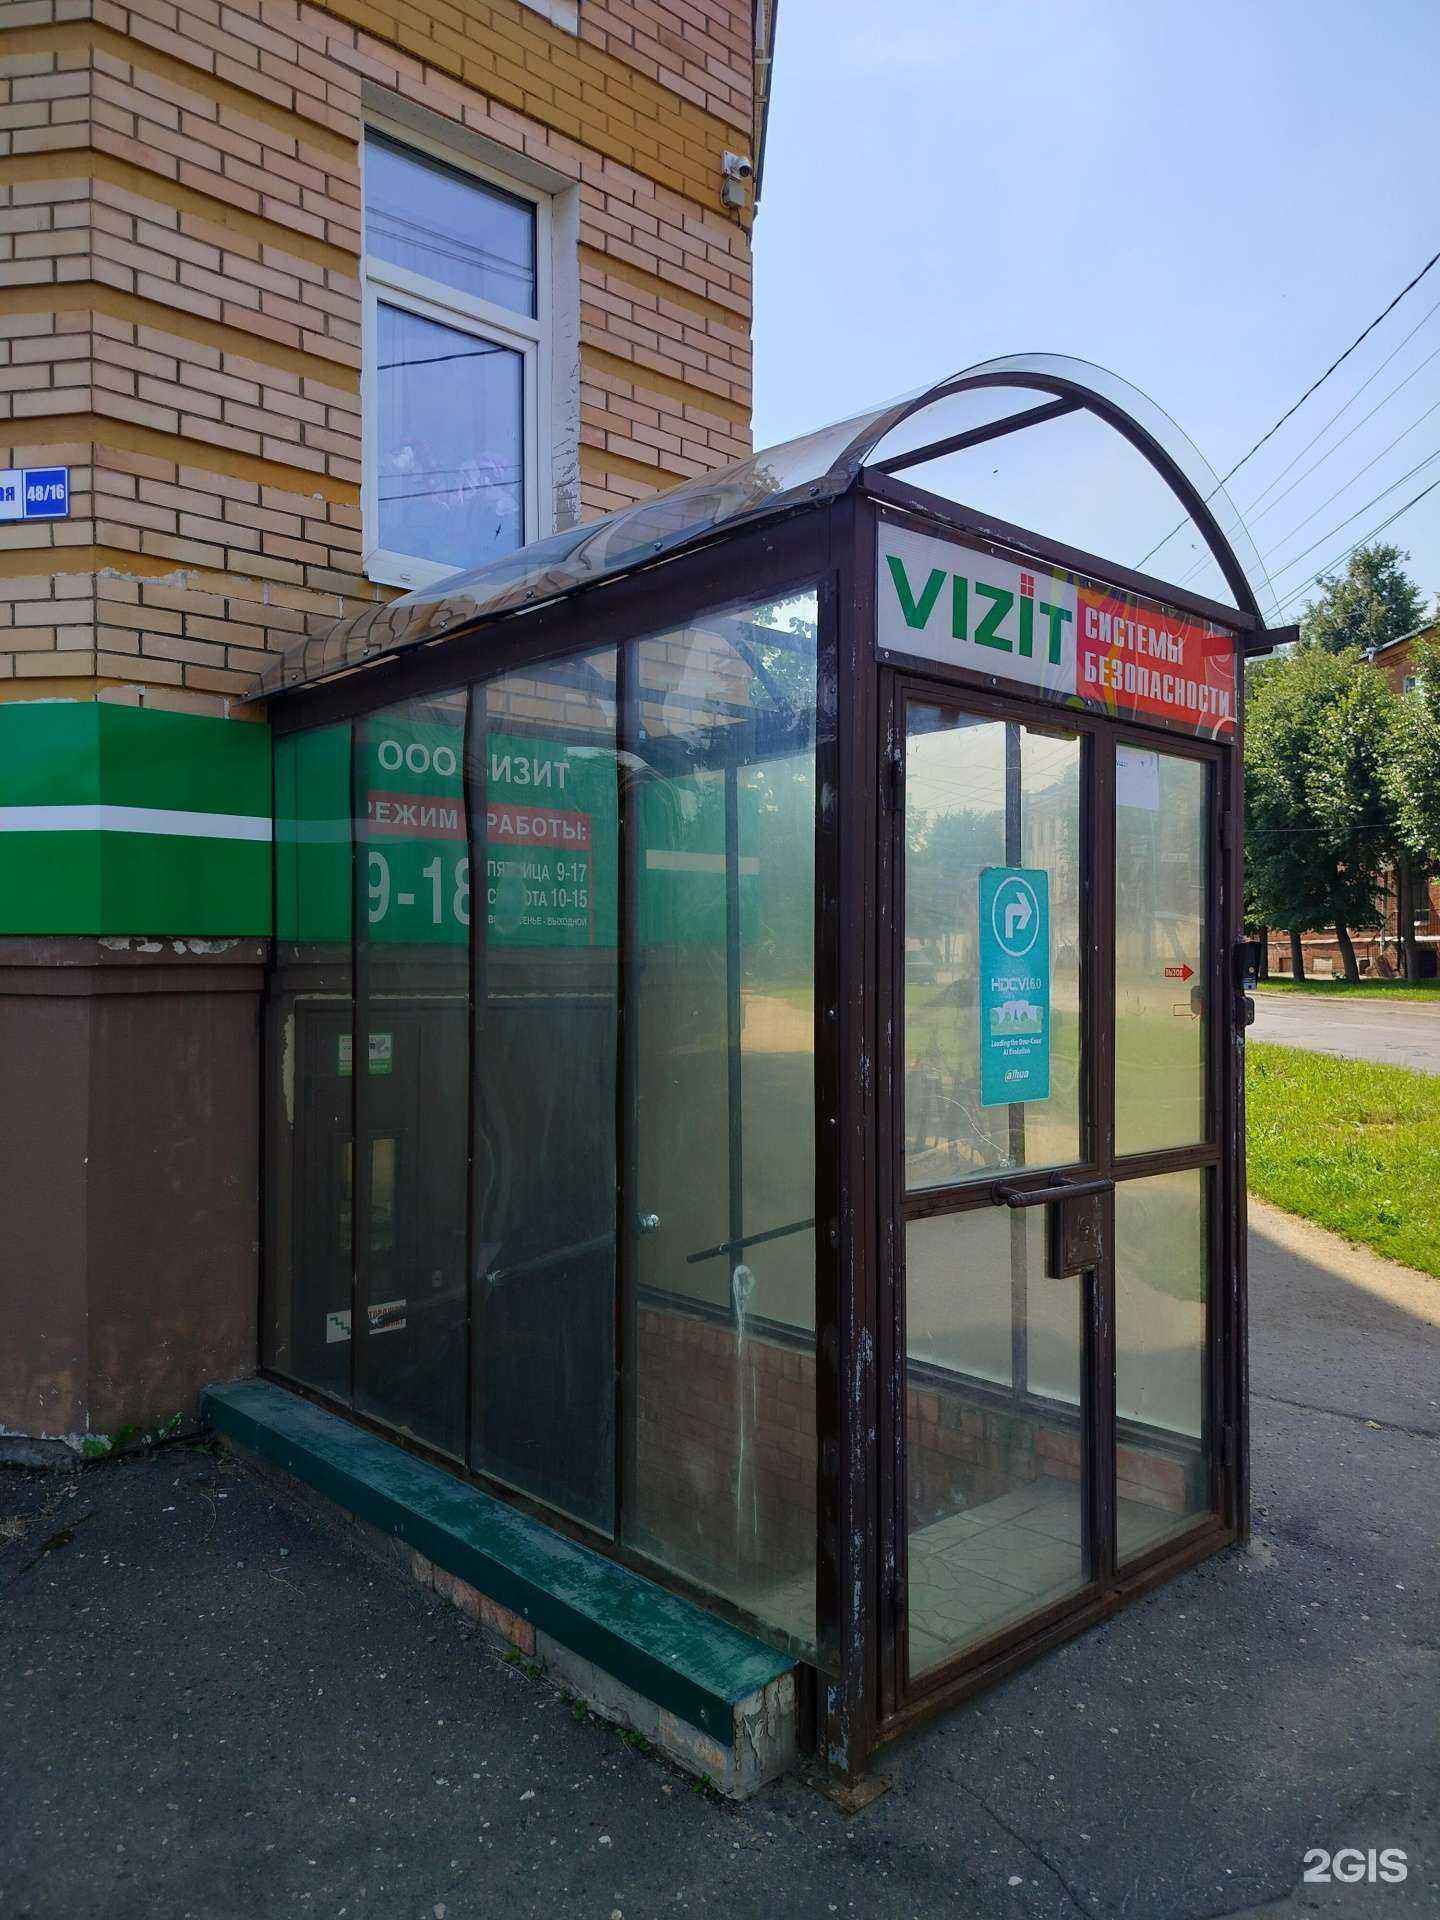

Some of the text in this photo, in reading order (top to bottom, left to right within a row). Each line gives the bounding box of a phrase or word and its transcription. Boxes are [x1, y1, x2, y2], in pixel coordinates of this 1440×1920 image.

[27, 484, 65, 501] 48/16
[885, 554, 1073, 665] VIZIT
[1085, 607, 1184, 665] СИСТЕМЫ
[1084, 651, 1230, 717] БЕЗОПАСНОСТИ
[378, 740, 570, 789] ООО ИЗИТ
[486, 813, 587, 841] РАБОТЫ:
[368, 851, 470, 925] 9-18
[557, 862, 587, 882] 9-17
[487, 888, 588, 908] СОТА 10-15
